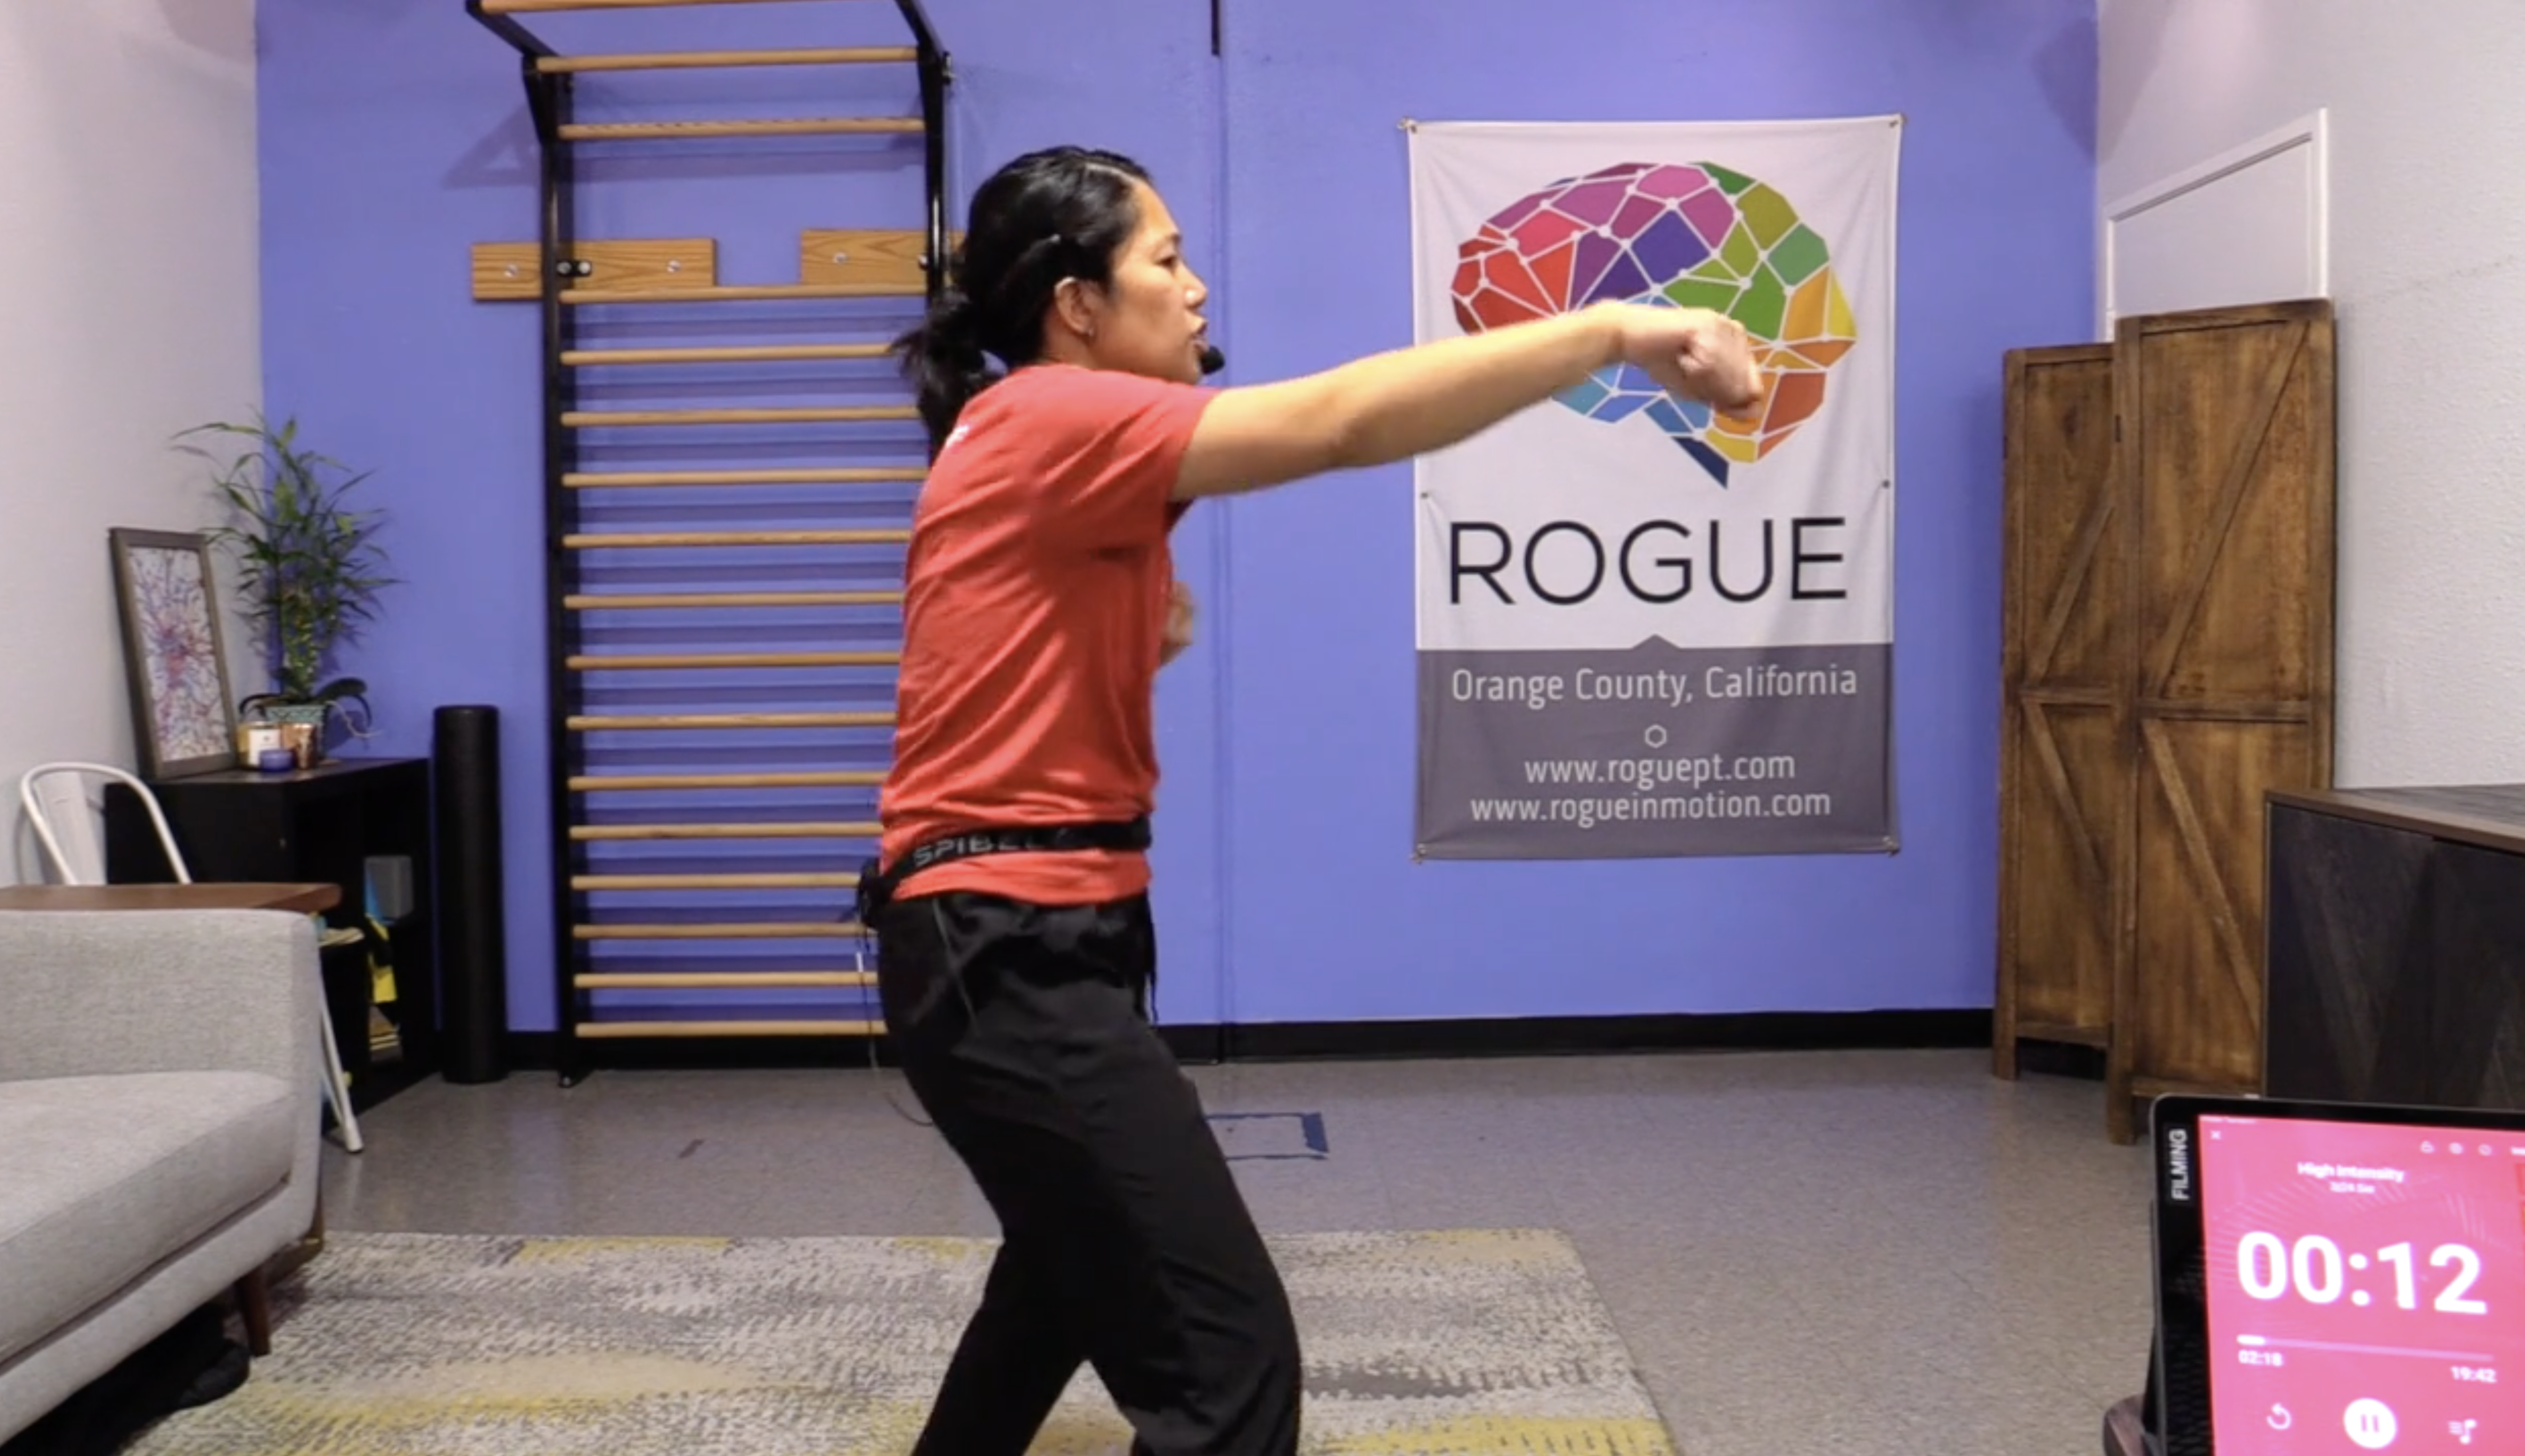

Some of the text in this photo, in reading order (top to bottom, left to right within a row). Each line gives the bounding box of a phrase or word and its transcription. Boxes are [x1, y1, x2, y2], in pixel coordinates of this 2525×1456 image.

[1450, 518, 1847, 605] ROGUE
[1452, 664, 1858, 709] Orange County, California
[1524, 755, 1795, 791] www.roguept.com
[1471, 791, 1832, 828] www.rogueinmotion.com
[2169, 1129, 2189, 1200] FILMING
[2297, 1161, 2404, 1183] High Intensity
[2237, 1231, 2488, 1315] 00:12
[2238, 1350, 2284, 1366] 02:18
[2451, 1366, 2497, 1383] 19:42
